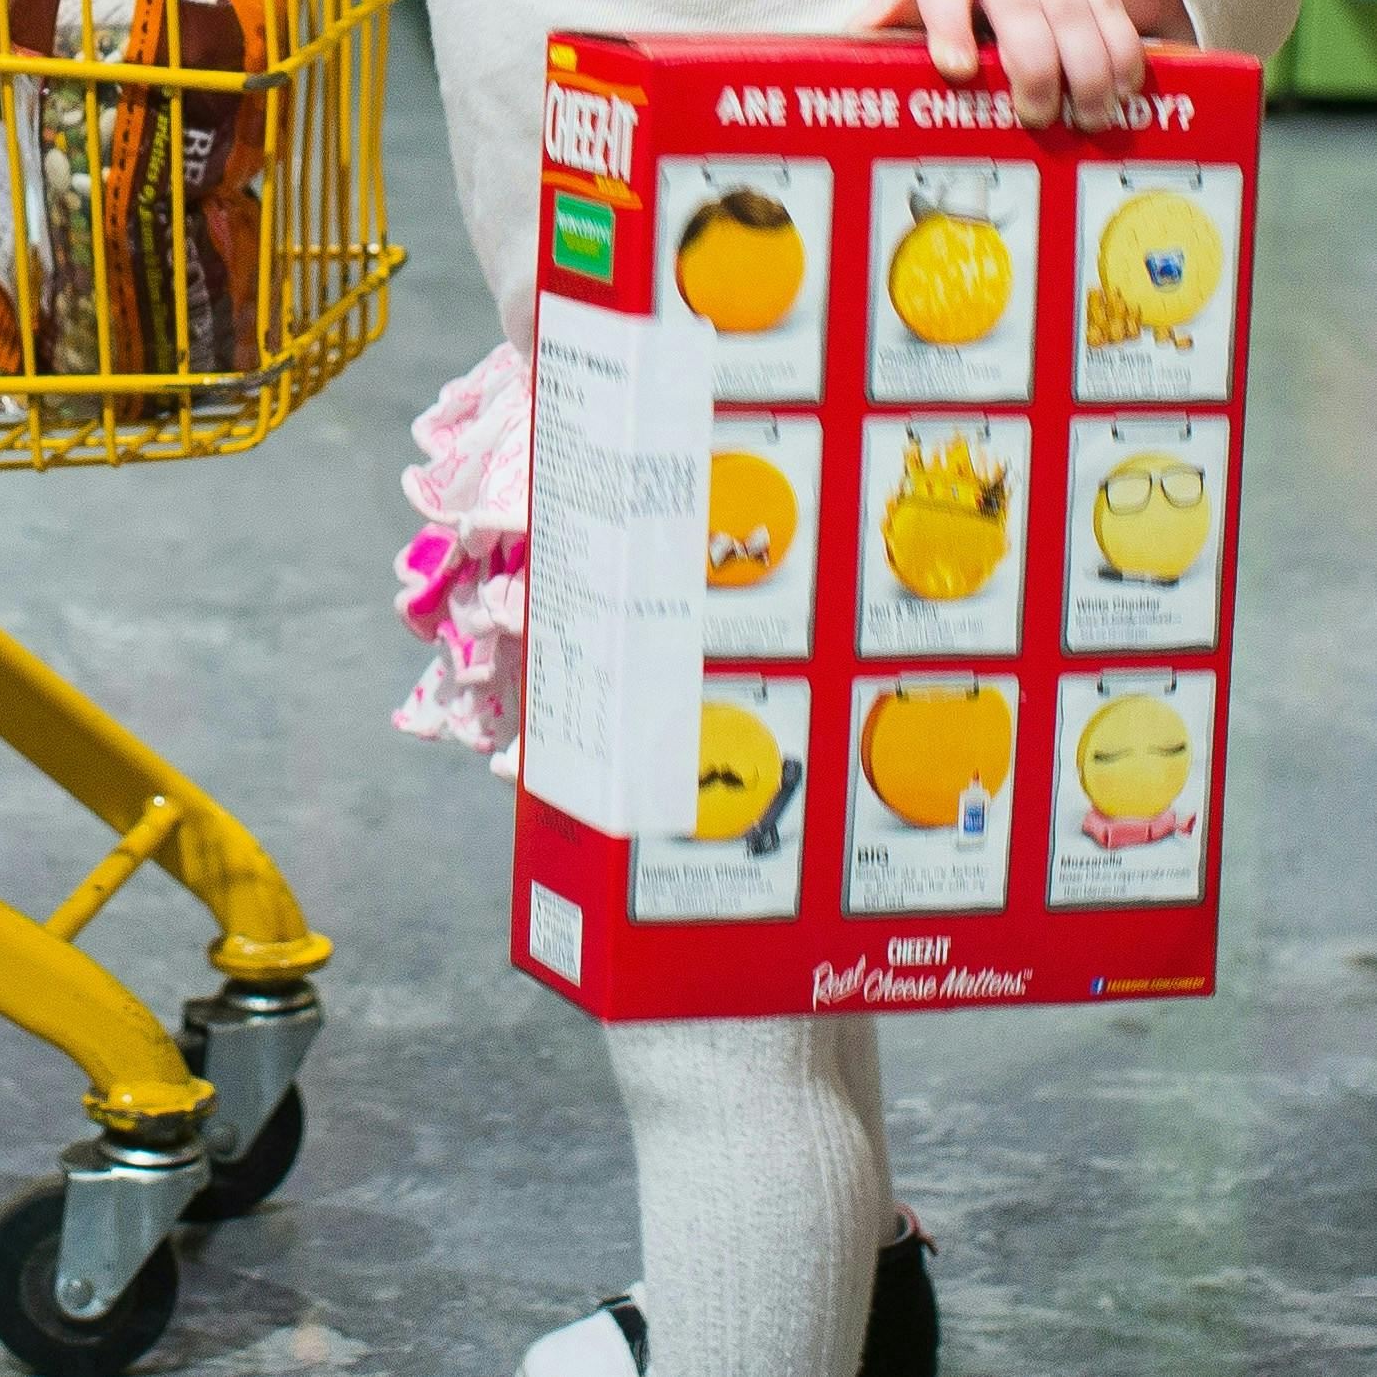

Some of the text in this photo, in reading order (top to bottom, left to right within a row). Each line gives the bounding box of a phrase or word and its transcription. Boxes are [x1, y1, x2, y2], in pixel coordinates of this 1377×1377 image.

[716, 85, 787, 127] ARE
[794, 86, 900, 129] THESE
[857, 845, 889, 866] BIG
[812, 954, 866, 1012] Real
[864, 966, 938, 1003] Cheese
